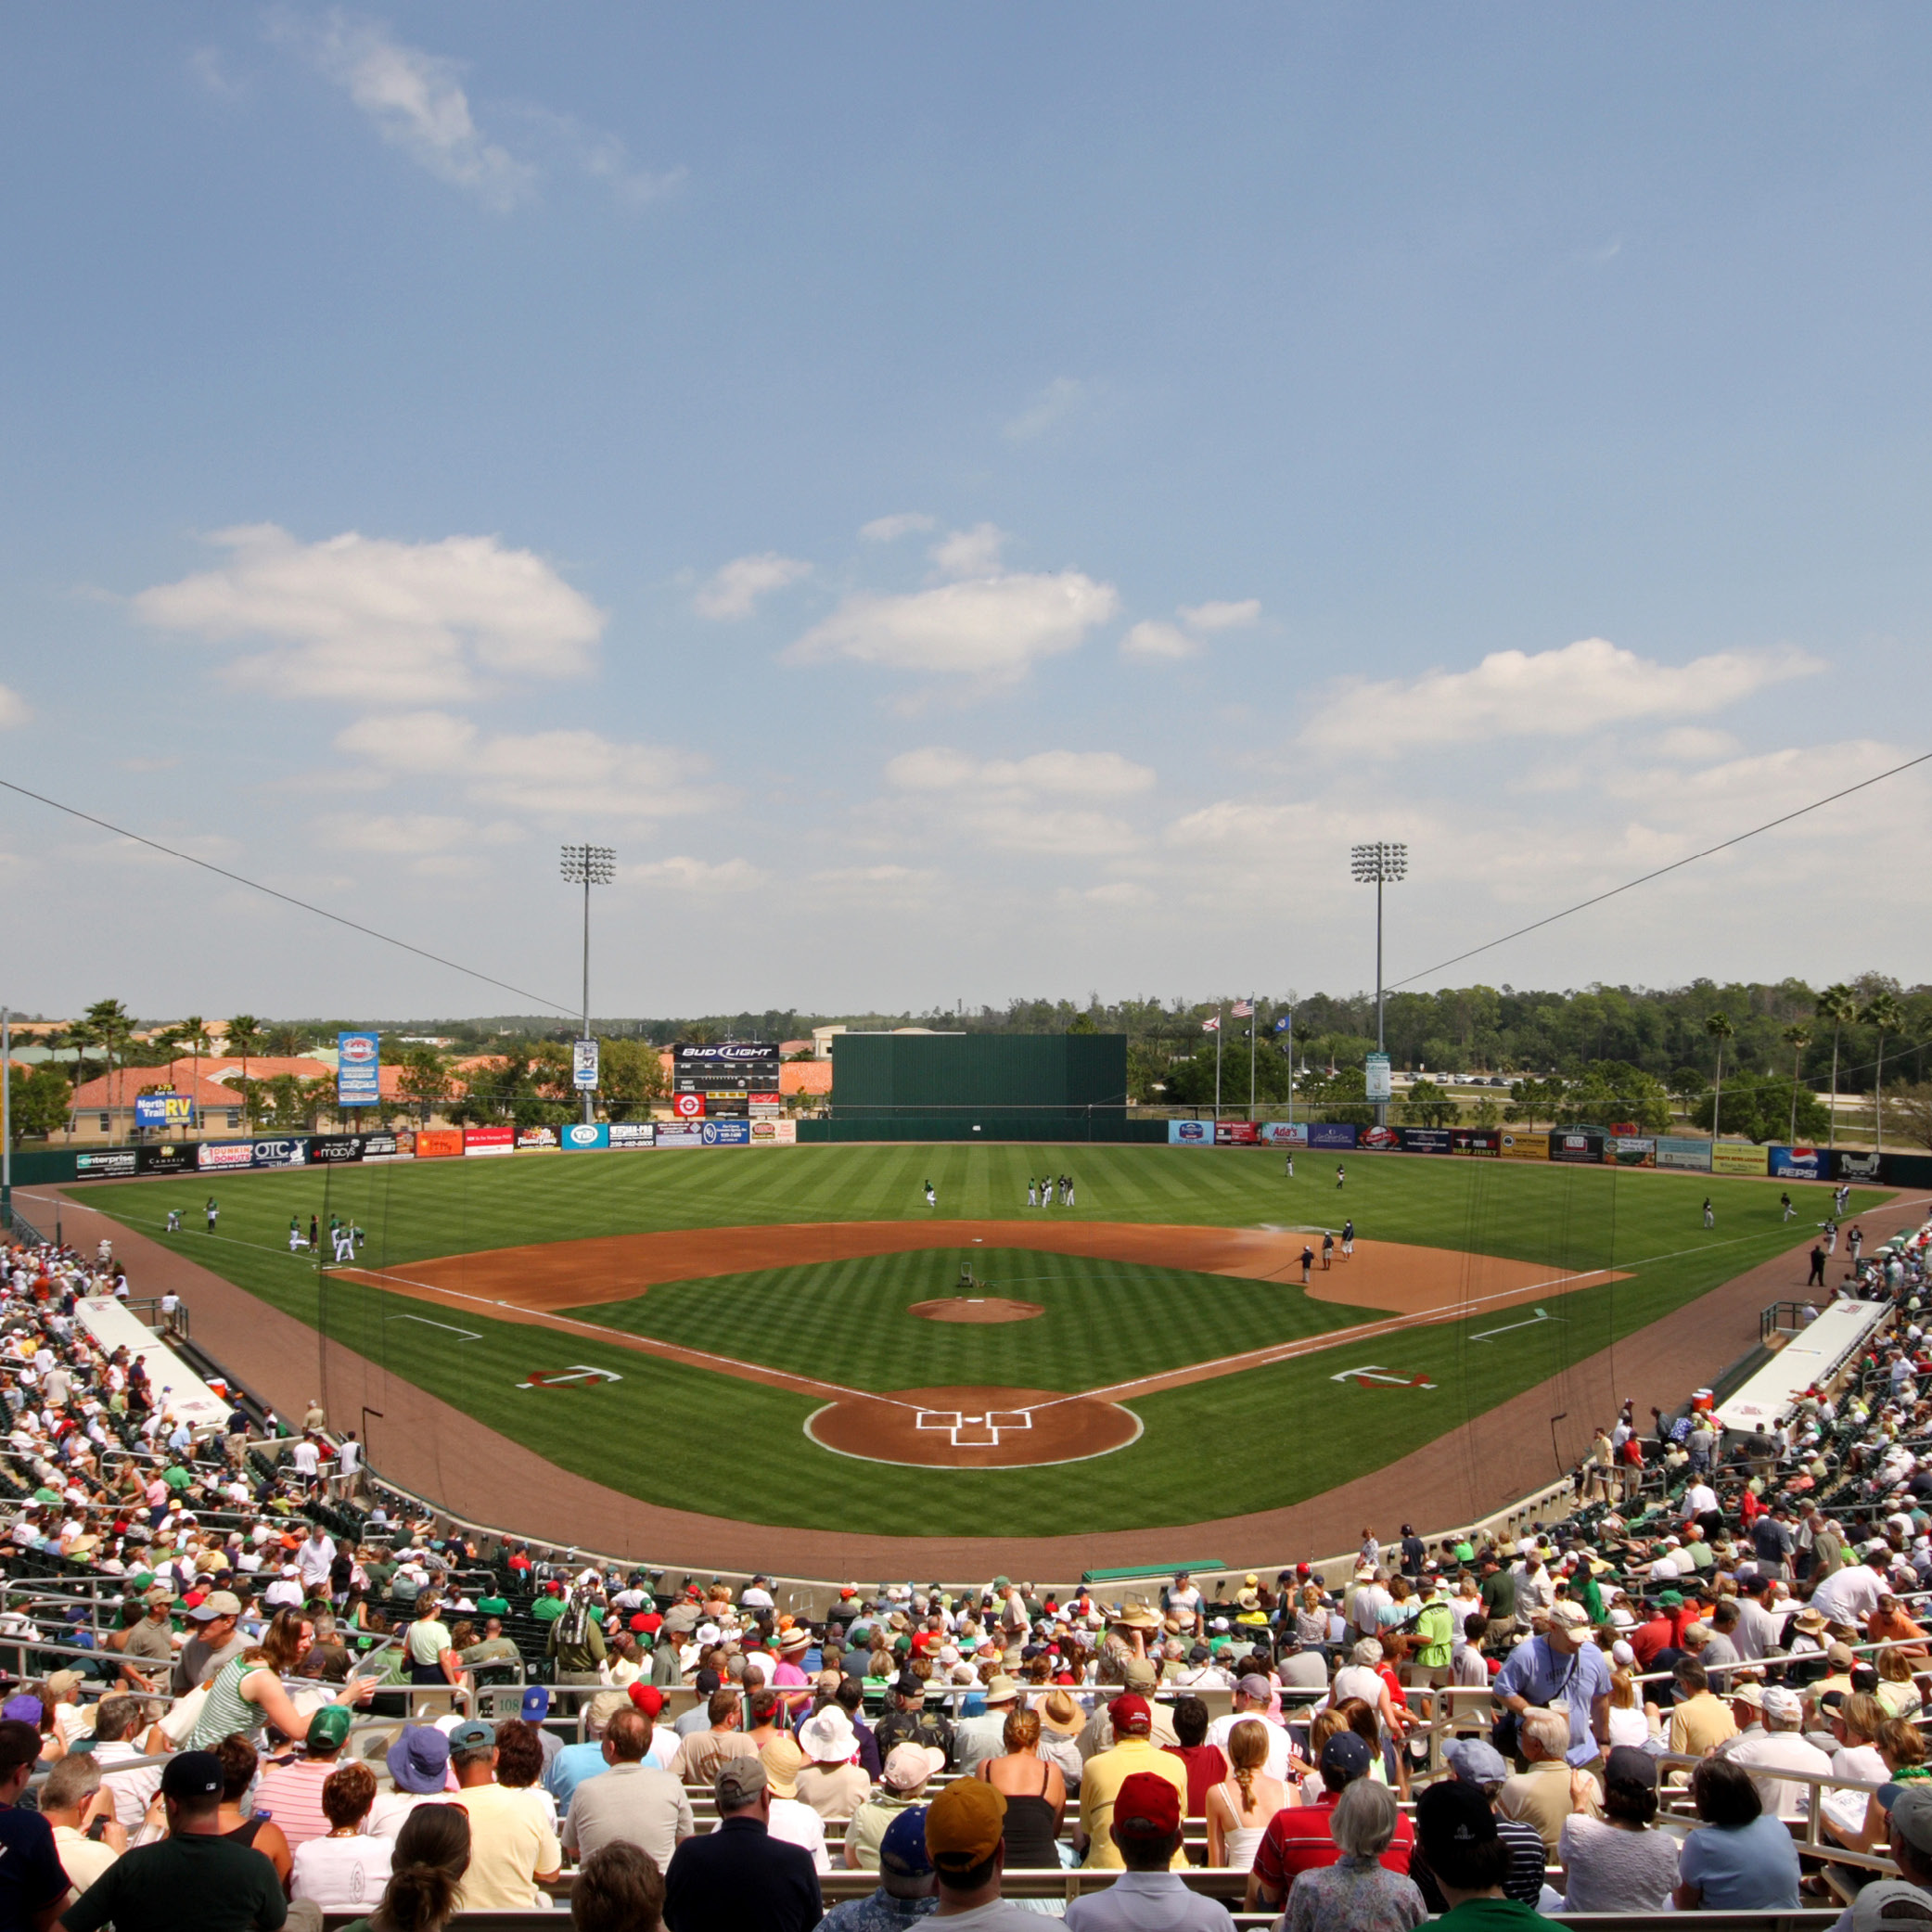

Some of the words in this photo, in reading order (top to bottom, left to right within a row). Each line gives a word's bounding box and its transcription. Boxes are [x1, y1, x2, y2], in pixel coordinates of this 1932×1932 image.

[682, 1048, 717, 1056] BUD
[725, 1048, 772, 1056] LIGHT
[137, 1100, 165, 1108] North
[165, 1098, 191, 1116] RV
[1273, 1127, 1298, 1137] Ada's
[255, 1141, 289, 1157] OTC
[1473, 1148, 1497, 1157] JERKY
[78, 1155, 134, 1166] enterprise
[214, 1154, 250, 1163] DONUTS
[1777, 1168, 1818, 1179] PEPSI
[500, 1699, 519, 1711] 108
